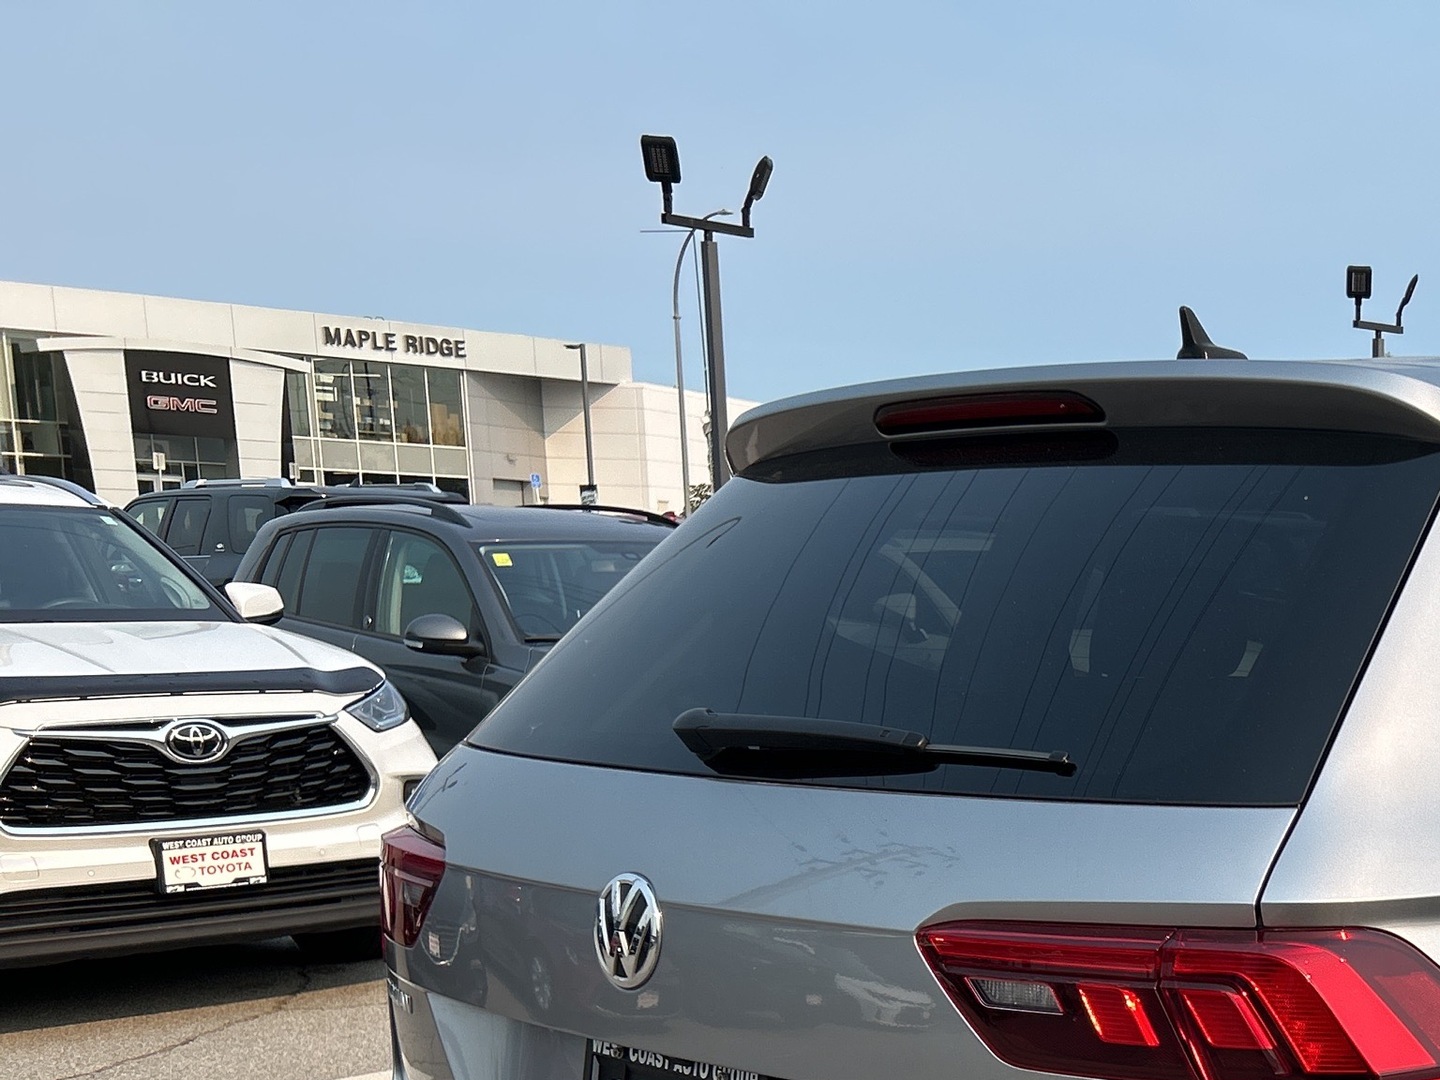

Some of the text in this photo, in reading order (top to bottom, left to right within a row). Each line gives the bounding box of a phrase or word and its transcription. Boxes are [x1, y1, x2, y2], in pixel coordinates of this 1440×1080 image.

[324, 326, 467, 358] MAPLE RIDGE
[141, 370, 217, 388] BUICK
[147, 394, 218, 414] GMC
[162, 840, 184, 850] WEST
[185, 837, 212, 848] COAST
[213, 835, 234, 846] AUTO
[169, 847, 256, 865] WEST COAST
[198, 861, 253, 876] TOYOTA
[592, 1039, 624, 1059] WES
